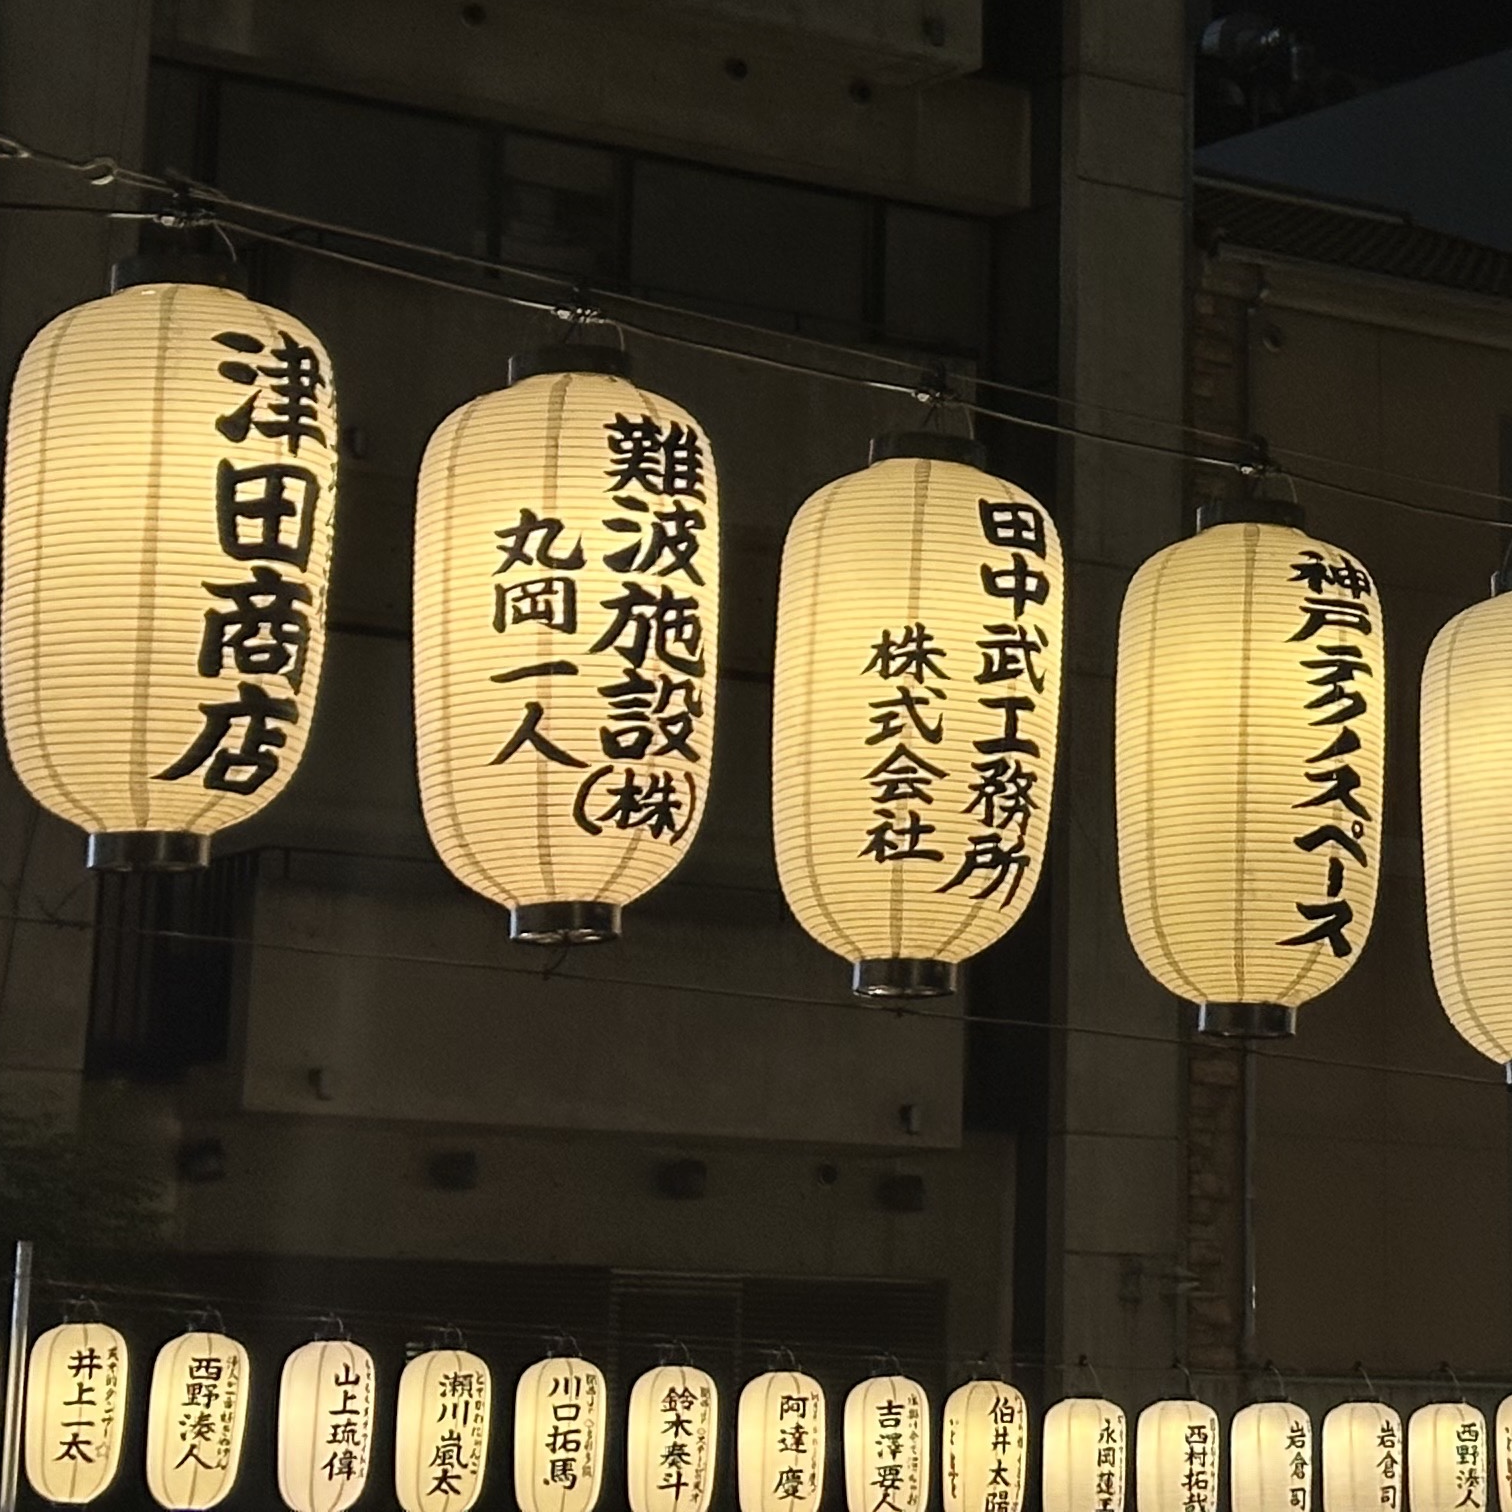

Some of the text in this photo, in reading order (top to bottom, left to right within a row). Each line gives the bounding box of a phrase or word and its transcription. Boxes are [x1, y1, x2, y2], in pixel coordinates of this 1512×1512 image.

[151, 329, 327, 795] 津田商店
[489, 509, 592, 768] 丸岡一人
[859, 623, 950, 863] 株式会社
[935, 498, 1050, 912] 田中武工務所
[1276, 550, 1374, 958] 神戸テクノスペース
[56, 1348, 102, 1463] 井上一太
[176, 1358, 222, 1469] 西野湊人
[544, 1377, 581, 1489] 川口拓馬
[659, 1387, 699, 1502] 鈴木奏斗
